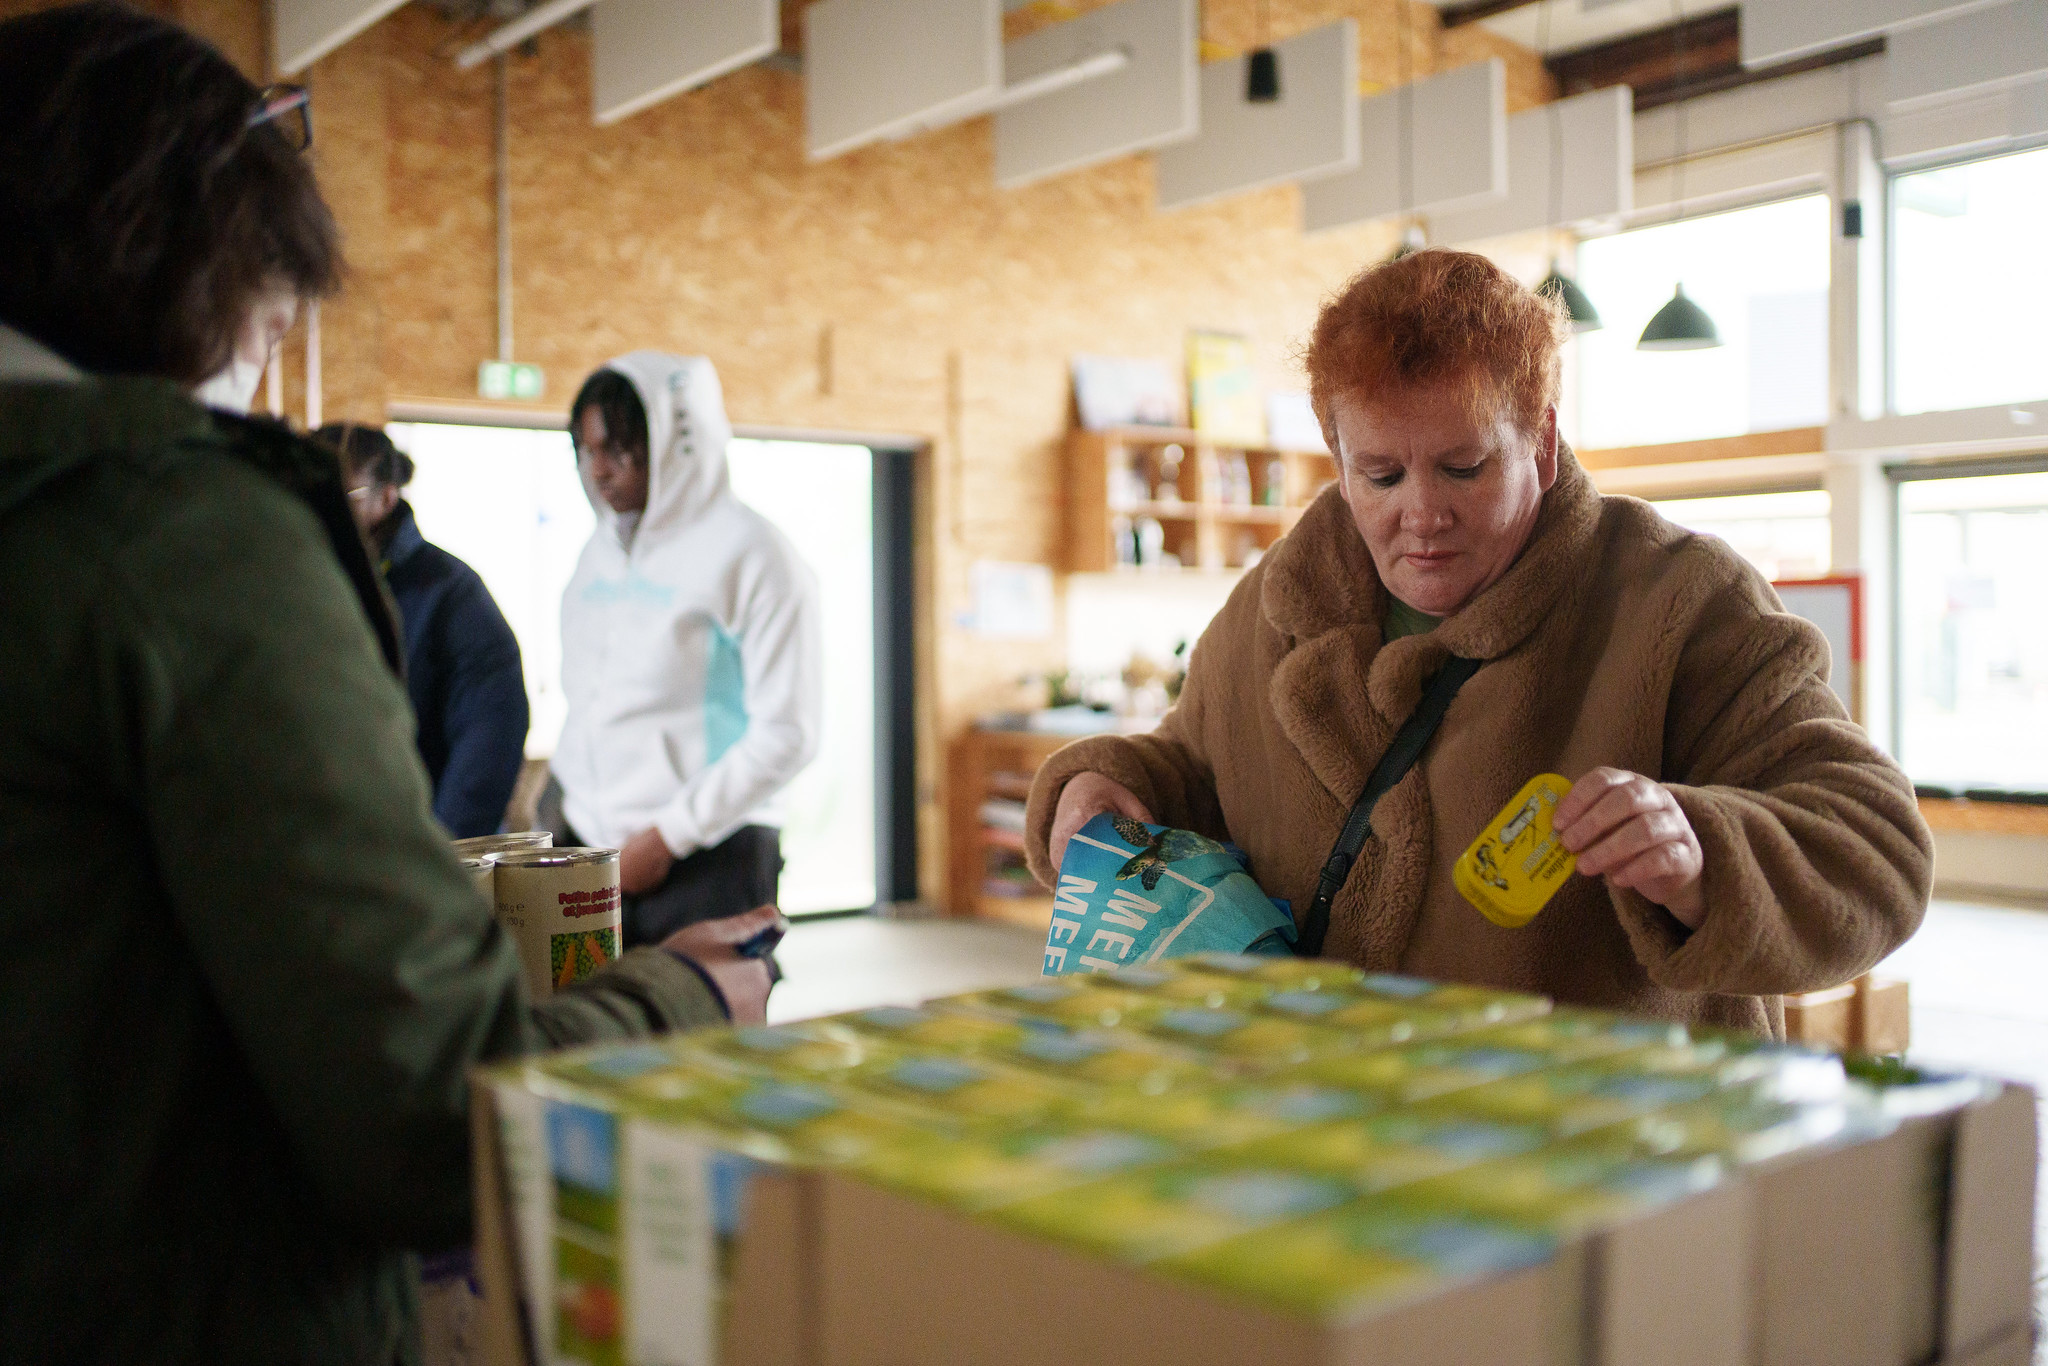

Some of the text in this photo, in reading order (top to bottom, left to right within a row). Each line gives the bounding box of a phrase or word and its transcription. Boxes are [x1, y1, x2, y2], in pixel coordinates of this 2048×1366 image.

[1542, 848, 1573, 881] ardines
[591, 887, 609, 903] pois
[563, 905, 575, 917] et
